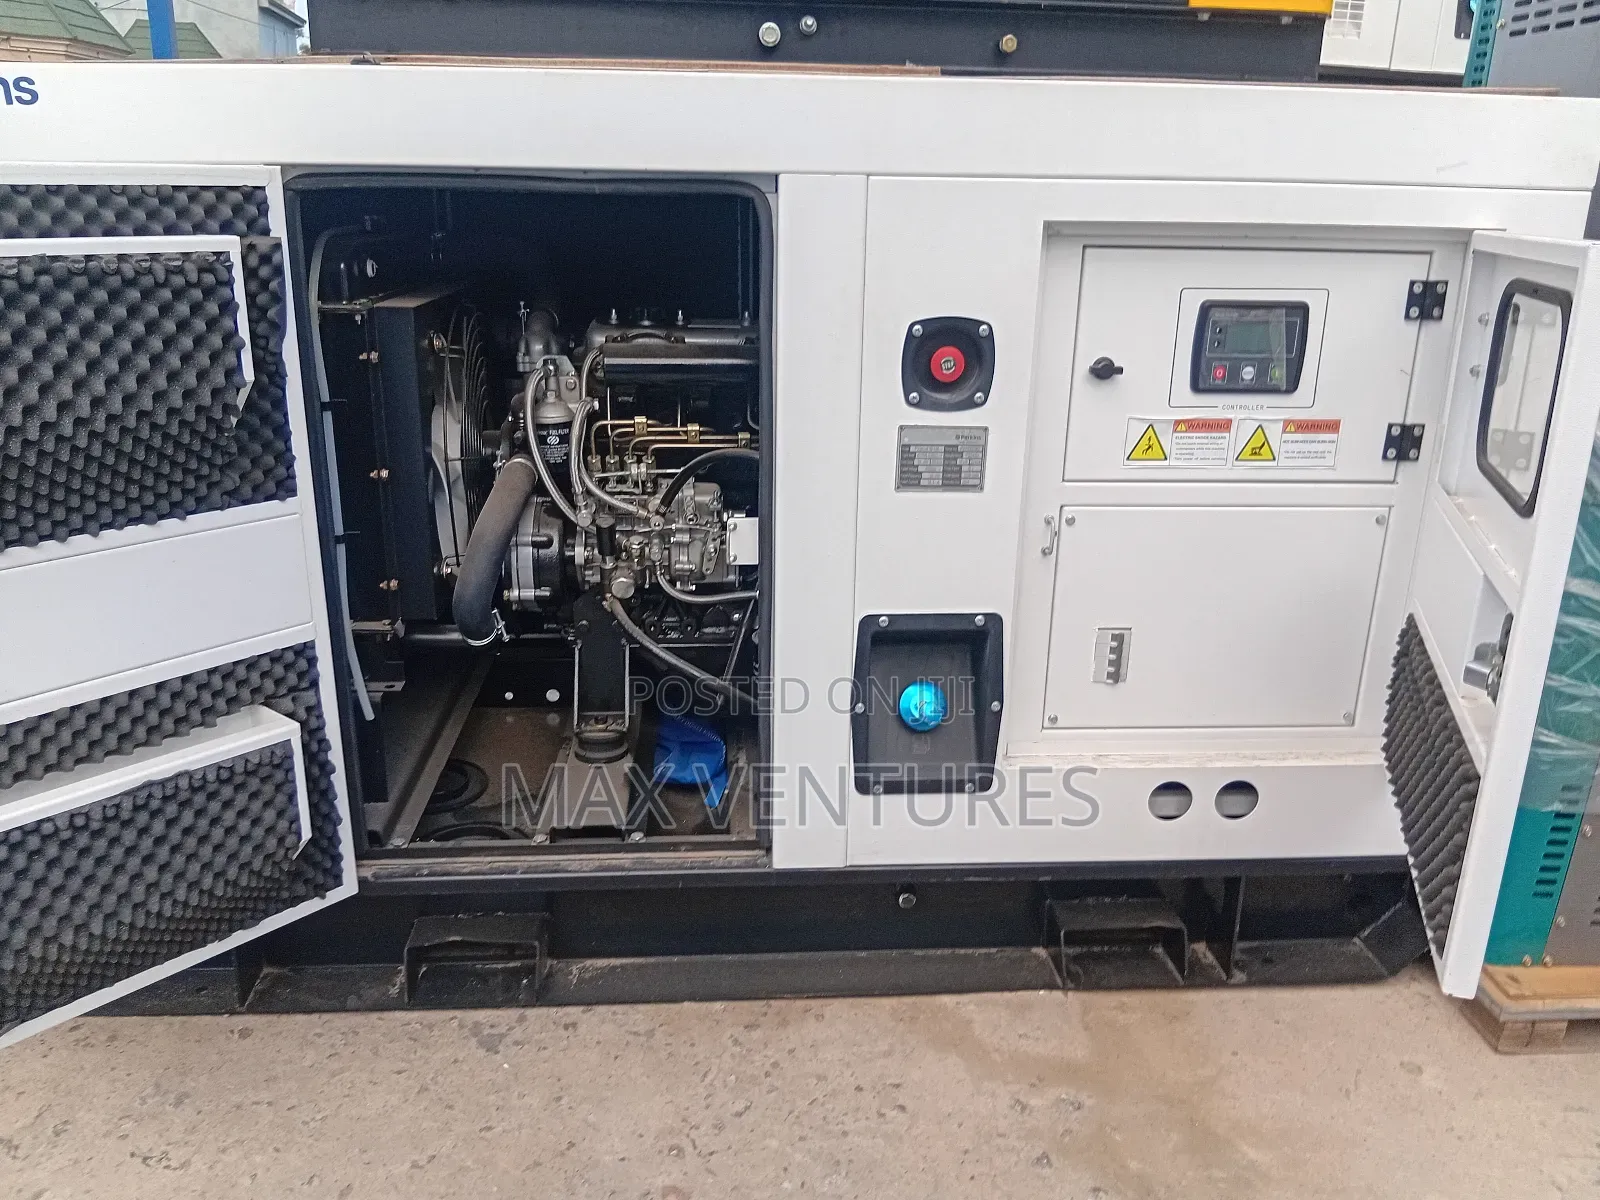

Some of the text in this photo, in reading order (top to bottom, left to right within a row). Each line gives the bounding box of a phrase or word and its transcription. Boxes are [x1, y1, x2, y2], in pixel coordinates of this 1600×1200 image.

[1221, 403, 1265, 411] CONTROLLER
[1187, 421, 1230, 431] WARNING
[1296, 422, 1338, 432] WARNING
